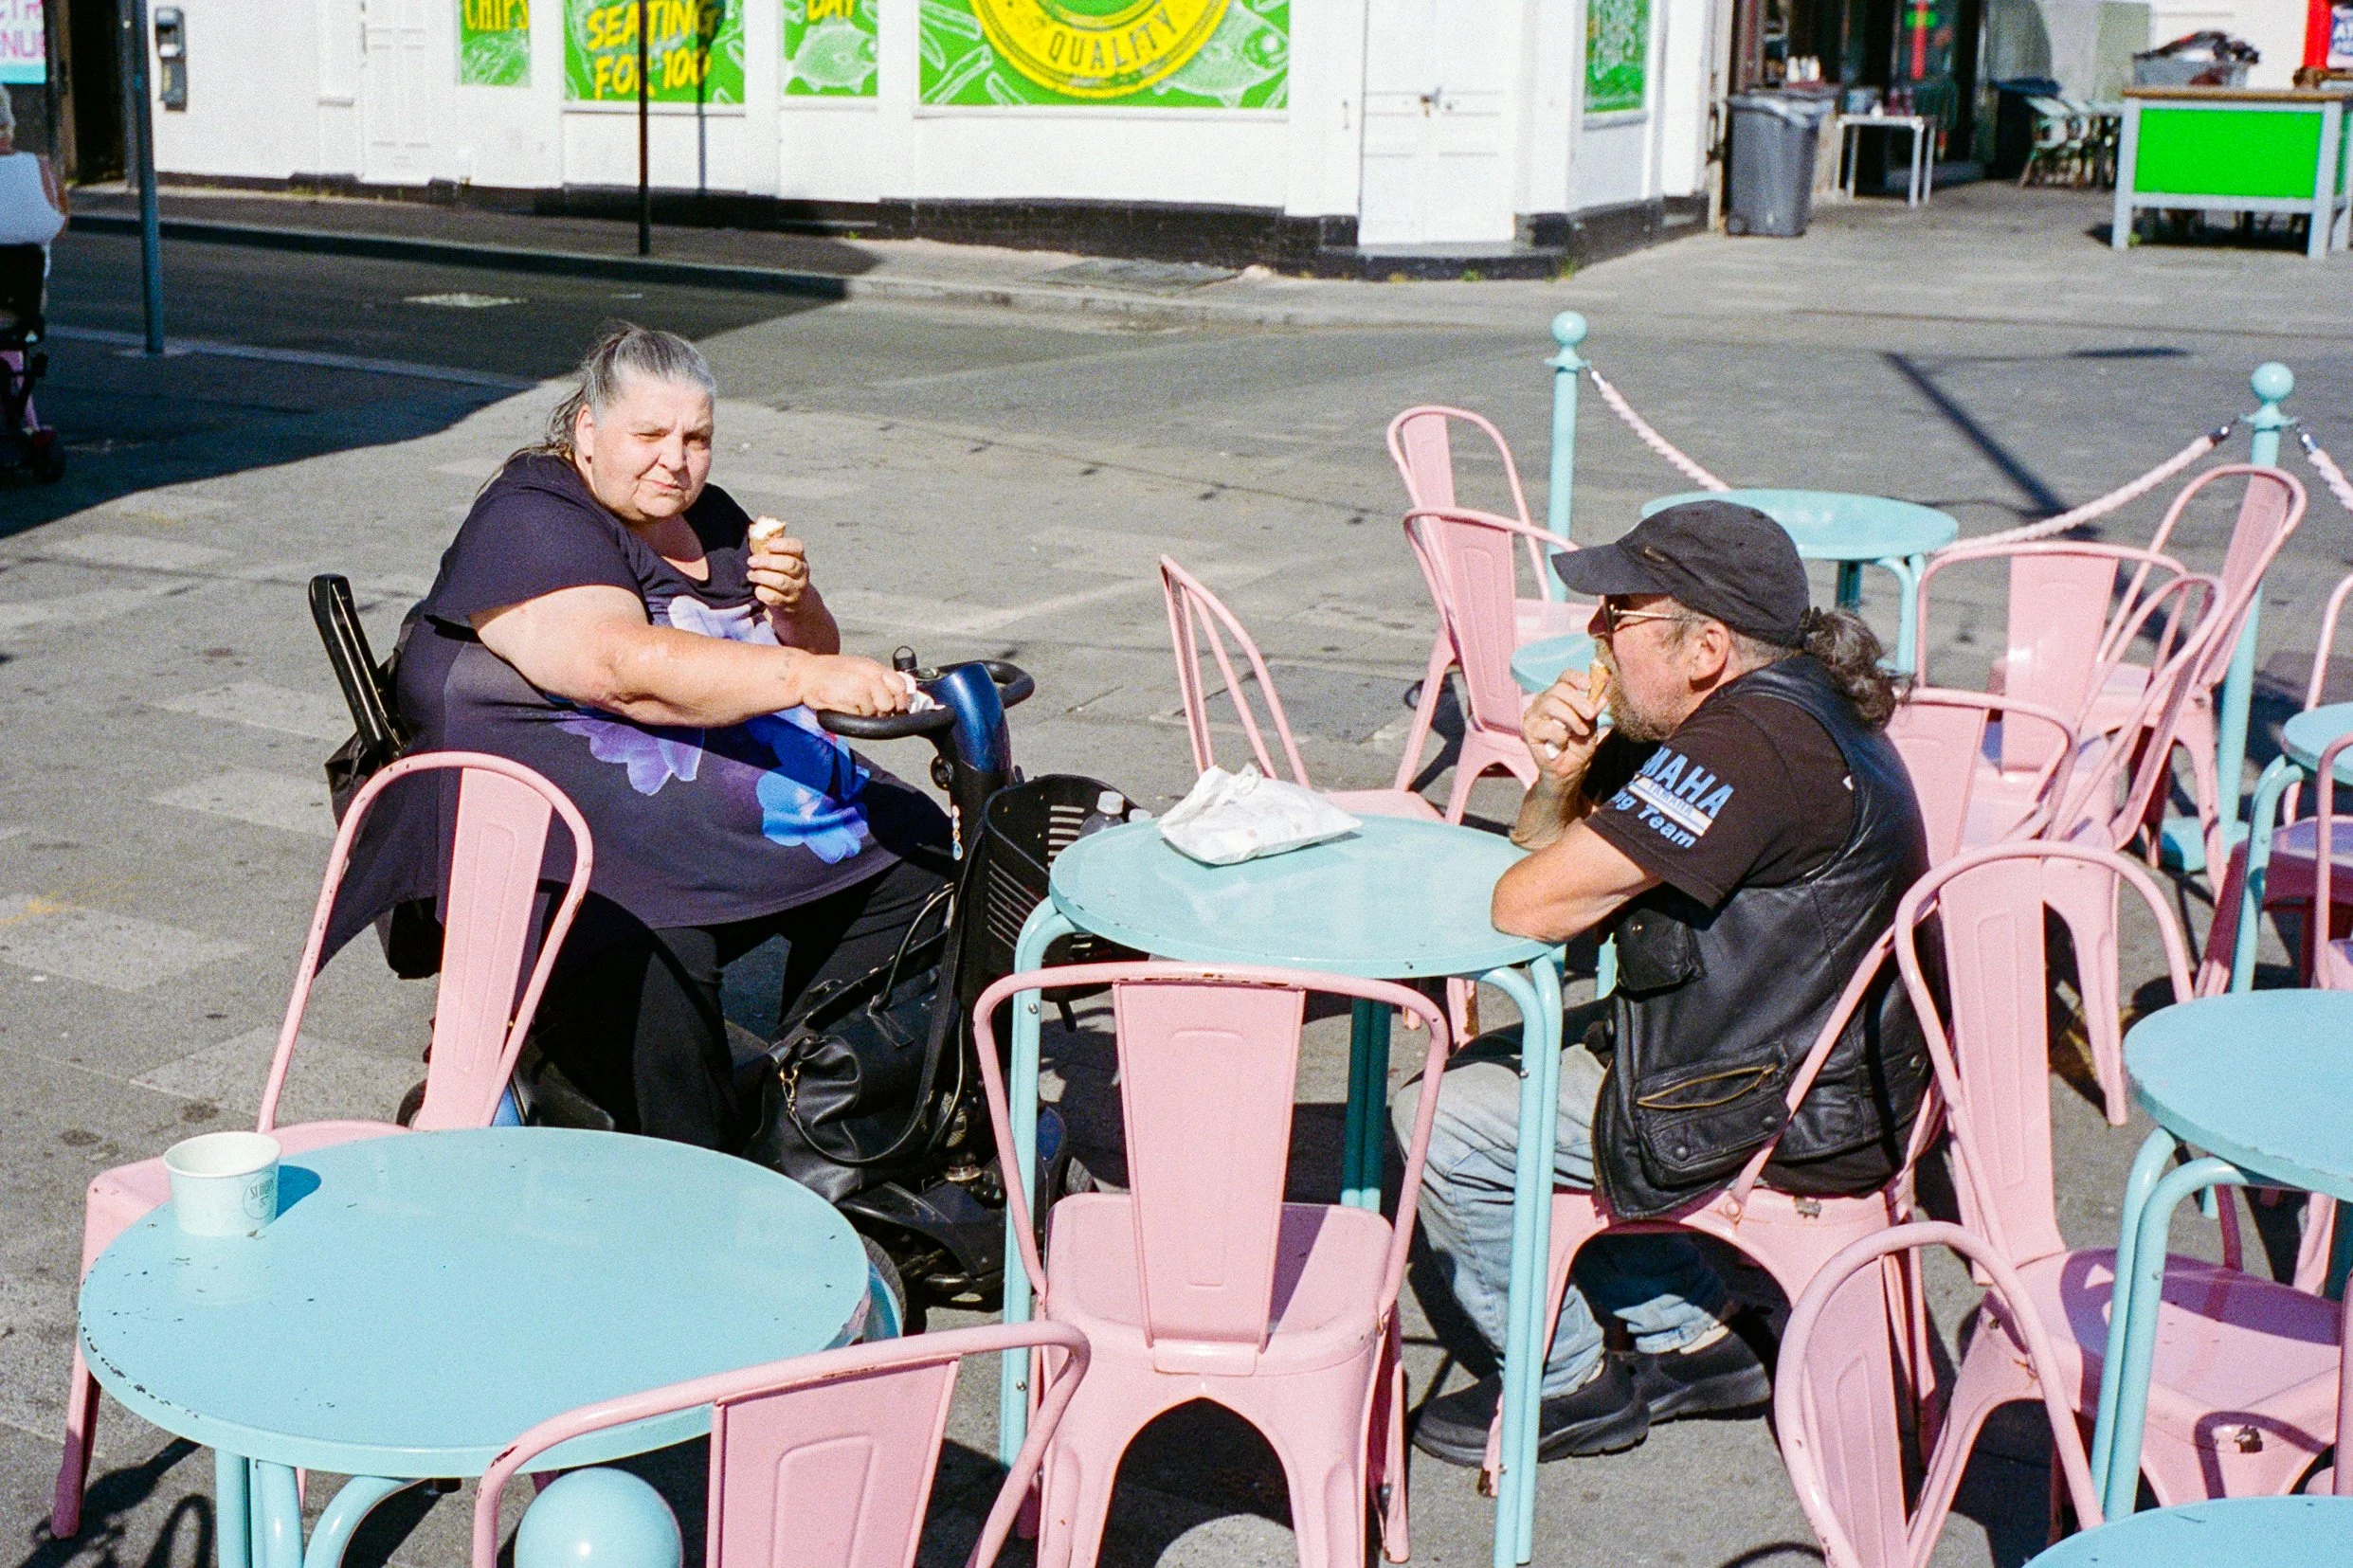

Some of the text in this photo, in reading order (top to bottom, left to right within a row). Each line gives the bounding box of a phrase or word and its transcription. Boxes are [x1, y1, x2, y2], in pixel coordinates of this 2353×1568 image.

[587, 0, 720, 50] SEATING
[1048, 8, 1177, 70] QUALITY
[663, 46, 712, 90] 100
[1638, 803, 1697, 849] Team
